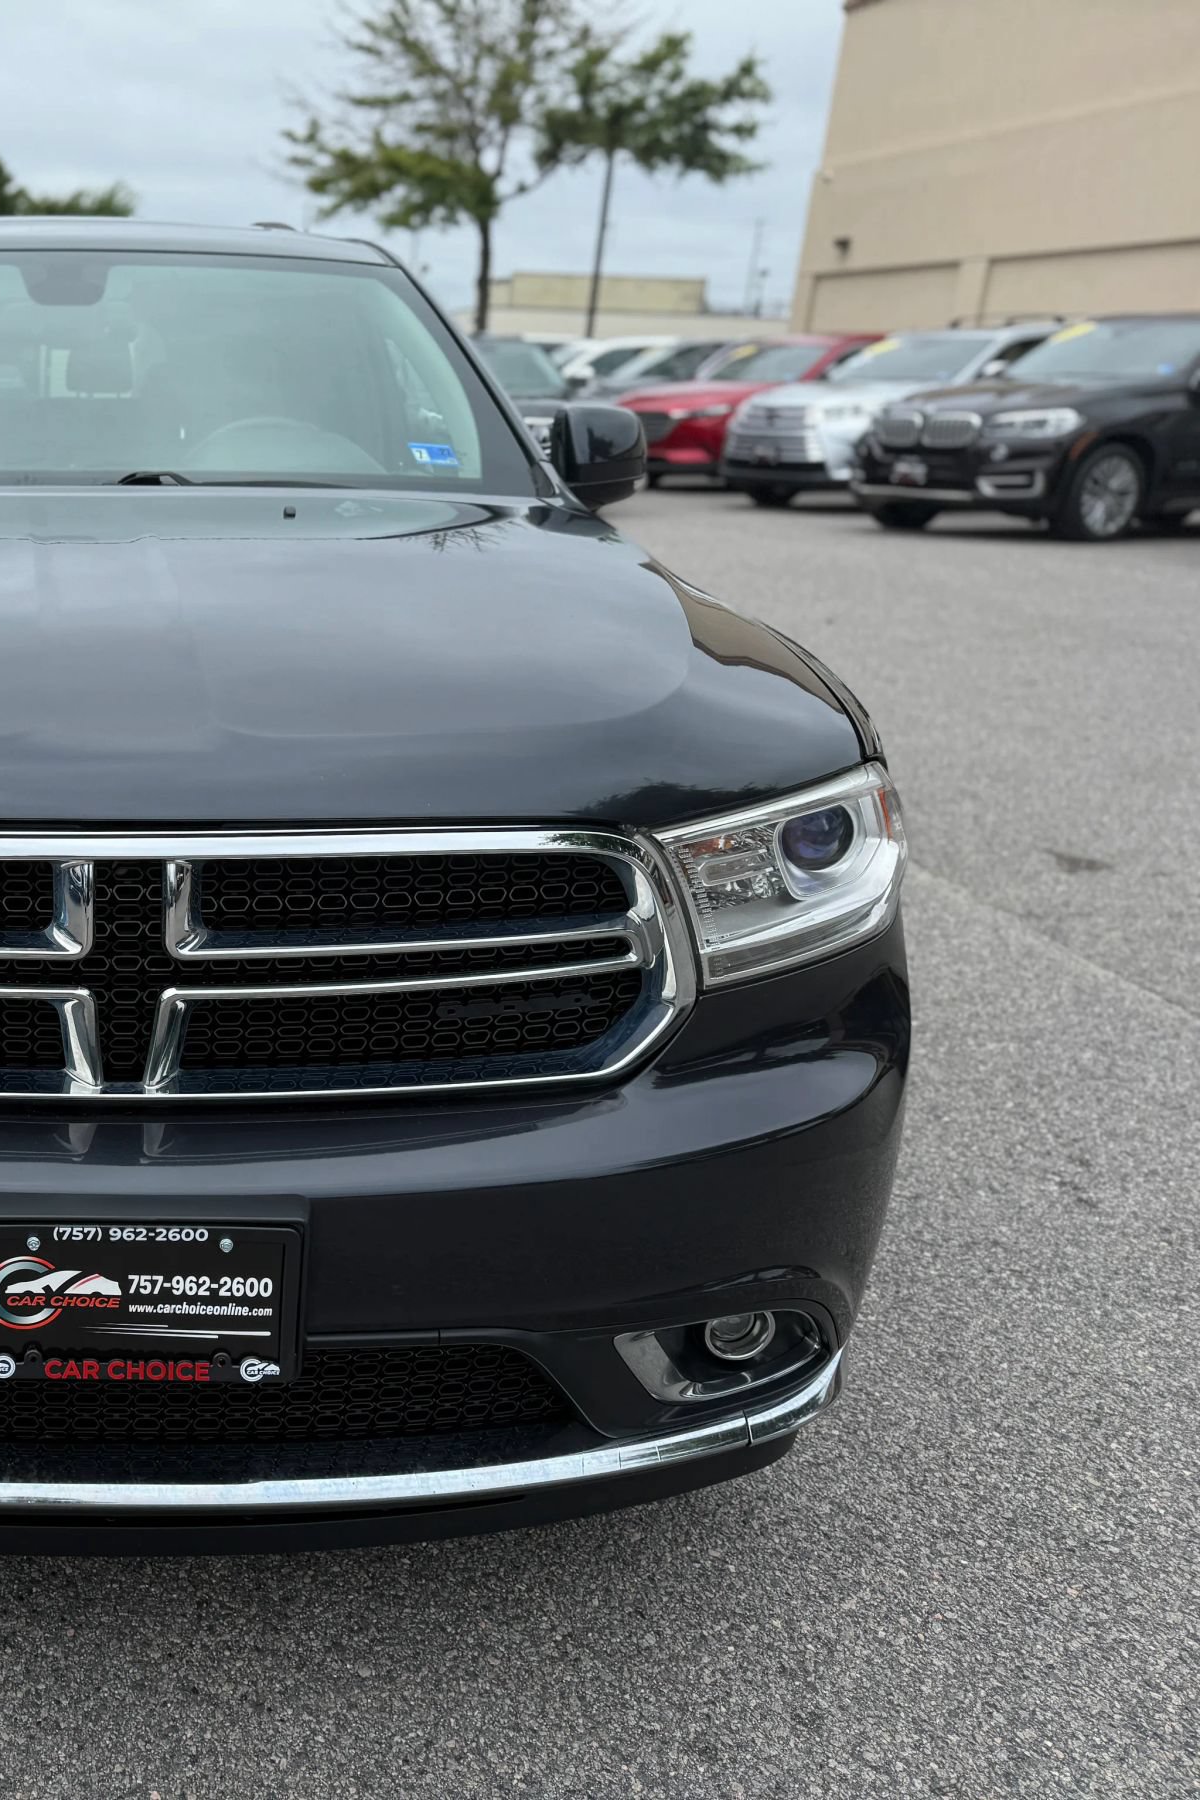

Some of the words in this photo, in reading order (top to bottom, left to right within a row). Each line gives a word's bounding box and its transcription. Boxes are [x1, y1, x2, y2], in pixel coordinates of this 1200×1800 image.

[53, 1226, 102, 1242] (757)
[108, 1227, 209, 1242] 962-2600
[128, 1274, 273, 1297] 757-962-2600
[6, 1295, 46, 1307] CAR
[50, 1295, 121, 1308] CHOICE
[128, 1301, 273, 1316] www.carchoiceonline.com
[44, 1360, 101, 1380] CAR
[107, 1361, 210, 1382] CHOICE
